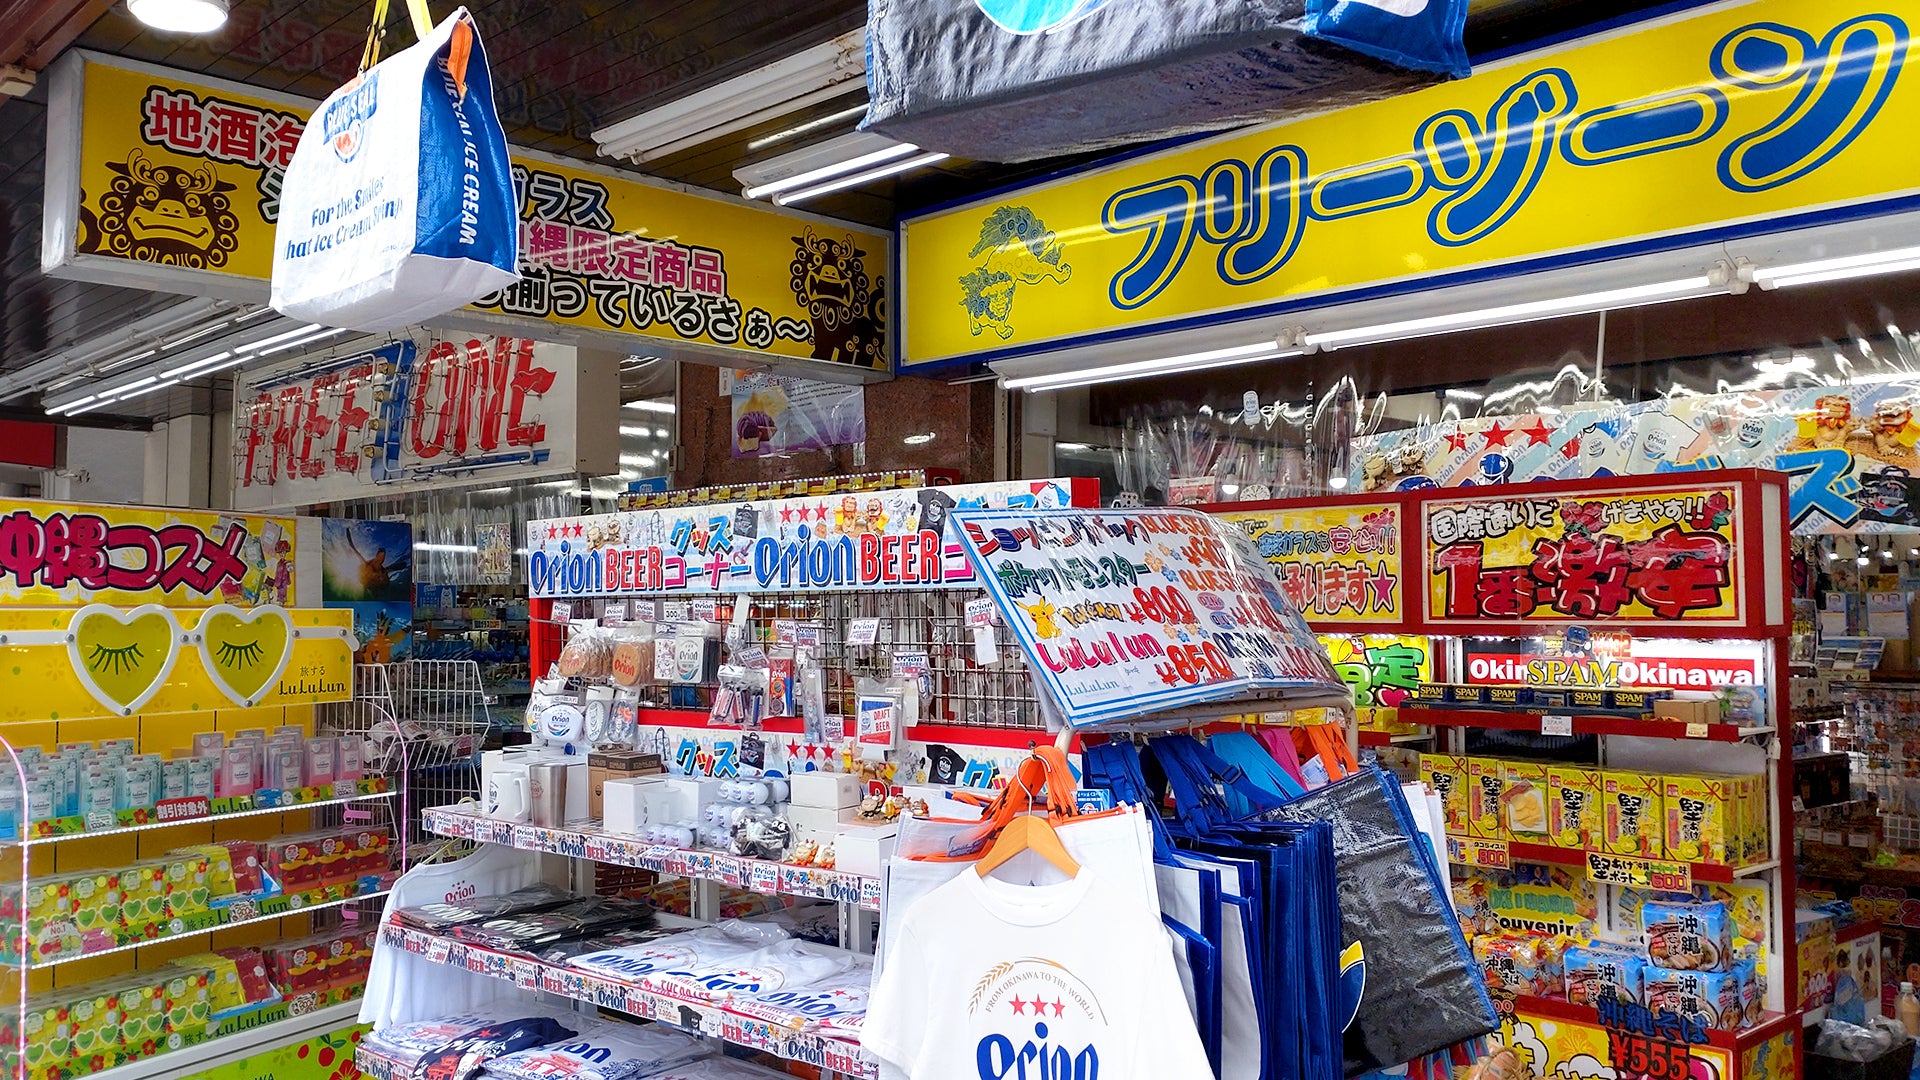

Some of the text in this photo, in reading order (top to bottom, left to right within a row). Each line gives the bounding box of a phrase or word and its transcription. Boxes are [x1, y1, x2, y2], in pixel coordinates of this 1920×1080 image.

[464, 136, 480, 172] ICE
[1102, 12, 1908, 311] フリーゾーン
[312, 206, 334, 228] For
[459, 173, 480, 245] CREAM
[518, 219, 724, 297] 縄限定商品
[1431, 496, 1705, 545] 国際通りで げきやす!!
[670, 515, 733, 554] グッズ
[754, 523, 857, 588] Orion
[861, 530, 944, 584] BEER
[530, 540, 664, 595] Orion BEER
[664, 551, 752, 591] コーナー
[968, 602, 994, 613] Orion
[1122, 585, 1197, 626] ¥800
[1154, 641, 1238, 688] ¥850
[1527, 658, 1622, 688] SPAM
[1617, 660, 1754, 687] Okinawa
[1420, 686, 1444, 695] SPAM
[1455, 687, 1480, 696] SPAM
[1490, 688, 1516, 698] SPAM
[1574, 691, 1602, 702] SPAM
[1615, 692, 1644, 704] SPAM
[873, 709, 891, 721] DRAFT
[875, 721, 891, 732] BEER
[676, 738, 741, 778] グッズ
[156, 801, 209, 821] 割引対象外
[1609, 872, 1637, 885] ポテト
[1651, 873, 1687, 890] 600
[444, 883, 476, 905] Orion
[831, 882, 859, 903] Orio
[1679, 914, 1701, 956] 沖縄
[1484, 955, 1515, 975] 沖縄
[627, 996, 649, 1017] BEER
[985, 971, 1096, 1021] FROM OKINAWA TO THE WORLD
[214, 1007, 288, 1038] LuLuLun
[744, 1020, 770, 1038] グッズ
[184, 1030, 214, 1045] 旅す
[826, 1052, 854, 1074] BEER
[1610, 1032, 1692, 1080] ¥555
